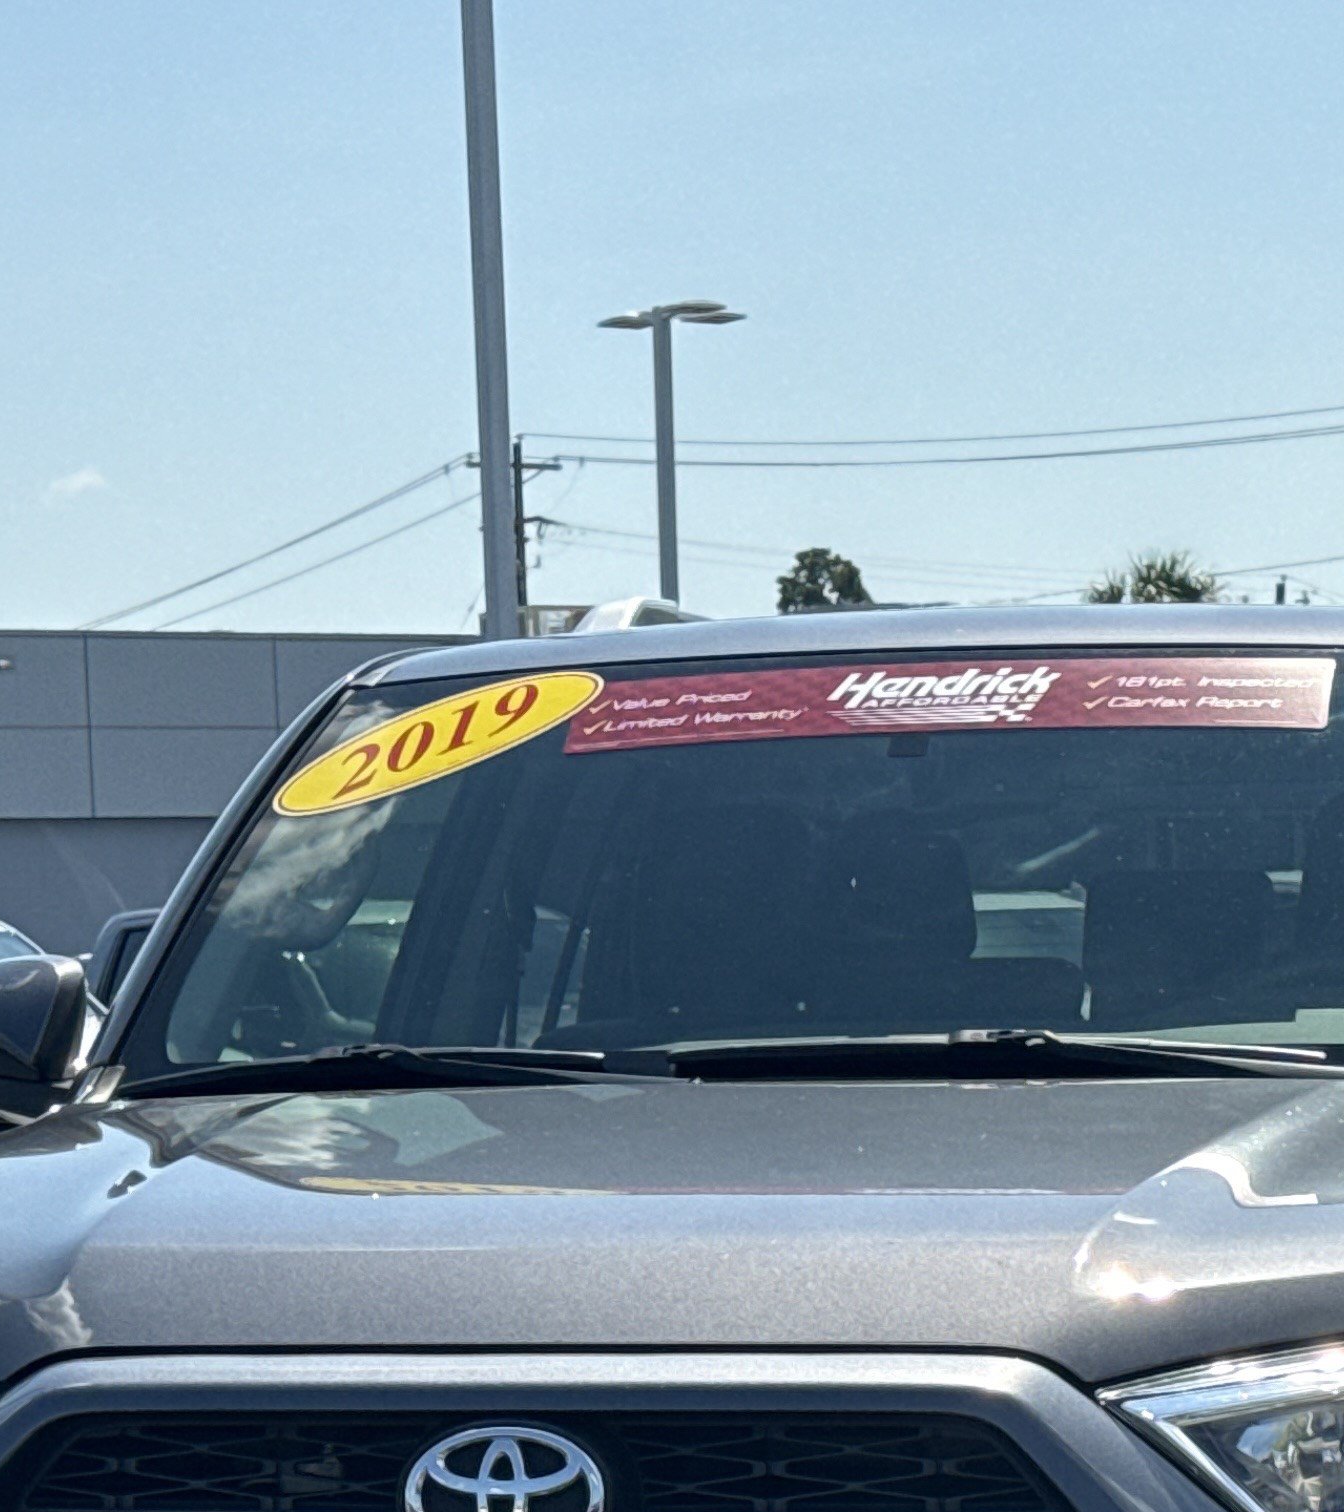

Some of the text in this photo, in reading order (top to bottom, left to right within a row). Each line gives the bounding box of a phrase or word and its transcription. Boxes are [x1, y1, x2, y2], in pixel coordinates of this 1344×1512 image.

[826, 666, 1062, 709] Hendrick
[1197, 676, 1315, 688] Inspected
[613, 689, 752, 711] Value Priced
[861, 693, 1045, 709] AFFORDABLE
[1107, 696, 1283, 709] Carfax Report
[603, 714, 690, 732] Limited
[331, 683, 538, 800] 2019
